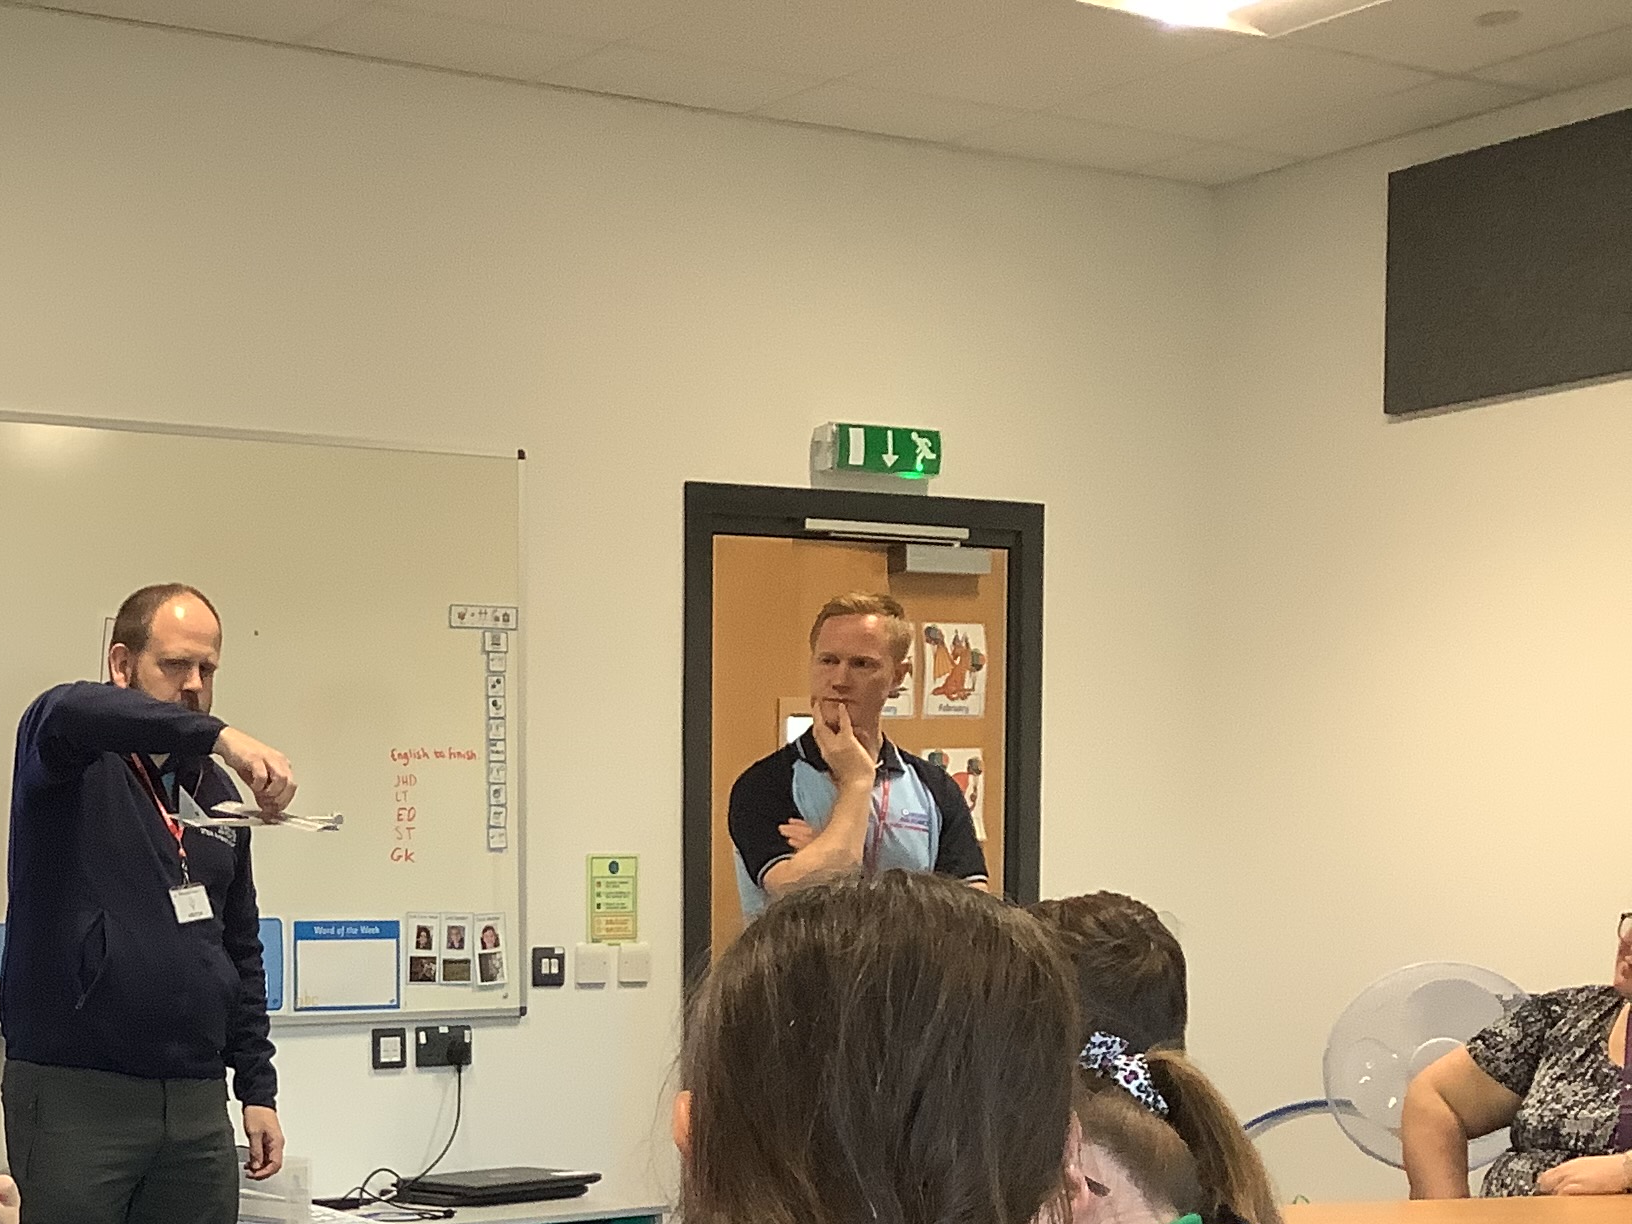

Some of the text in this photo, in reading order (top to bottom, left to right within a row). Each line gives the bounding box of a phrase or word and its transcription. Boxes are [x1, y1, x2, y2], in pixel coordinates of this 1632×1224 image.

[937, 703, 970, 714] February
[390, 746, 477, 767] English to finish
[395, 790, 409, 803] LT
[396, 806, 417, 822] ED
[394, 826, 416, 841] ST
[313, 924, 381, 938] Word of the Week
